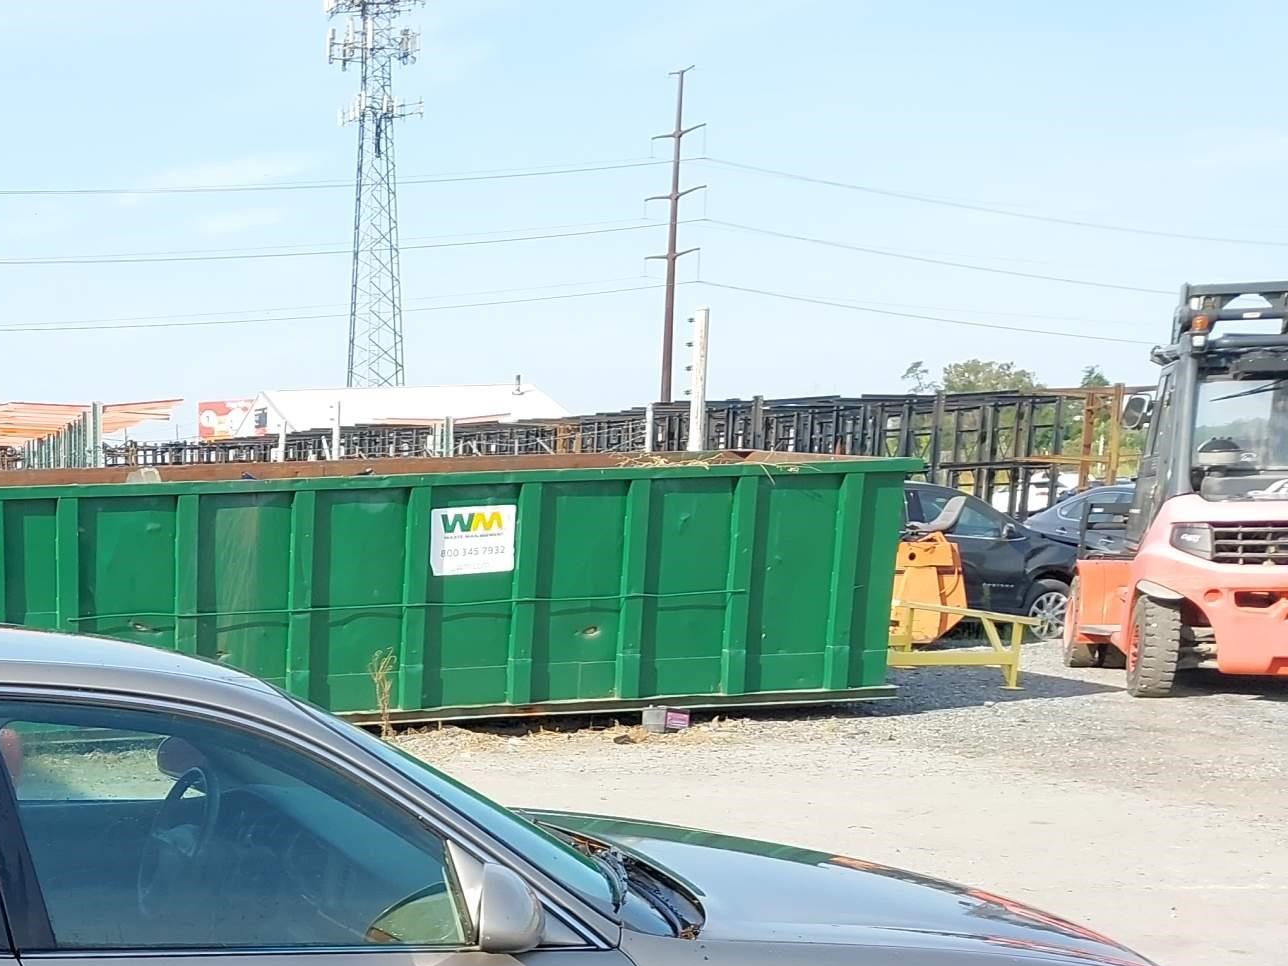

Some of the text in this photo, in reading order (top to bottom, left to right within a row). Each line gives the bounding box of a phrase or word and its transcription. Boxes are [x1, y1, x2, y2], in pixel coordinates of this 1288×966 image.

[441, 512, 502, 533] WM
[440, 545, 505, 558] 800 345 7932
